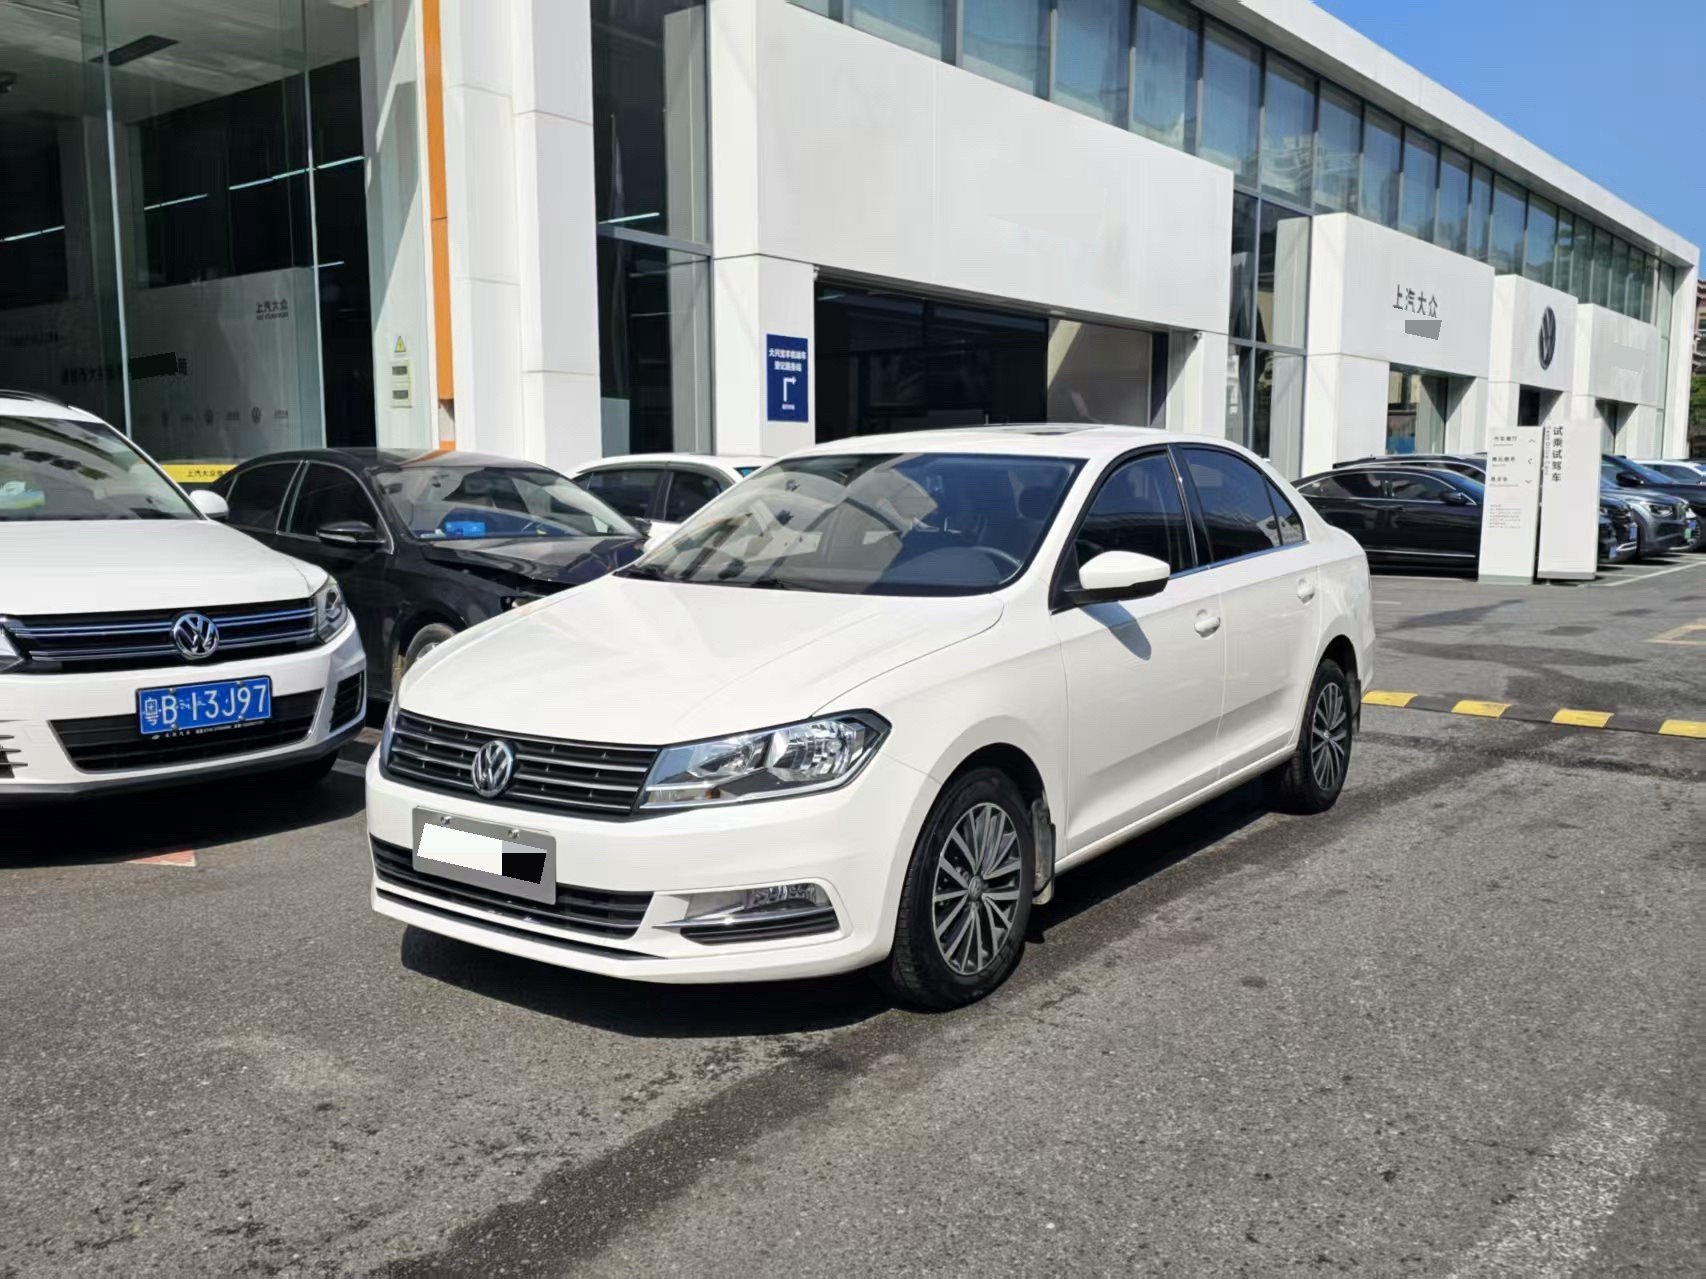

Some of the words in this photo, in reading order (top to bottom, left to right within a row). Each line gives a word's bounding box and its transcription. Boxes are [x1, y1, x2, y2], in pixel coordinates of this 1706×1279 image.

[1392, 283, 1438, 319] 上汽大众
[1552, 426, 1563, 482] 试乘试驾车
